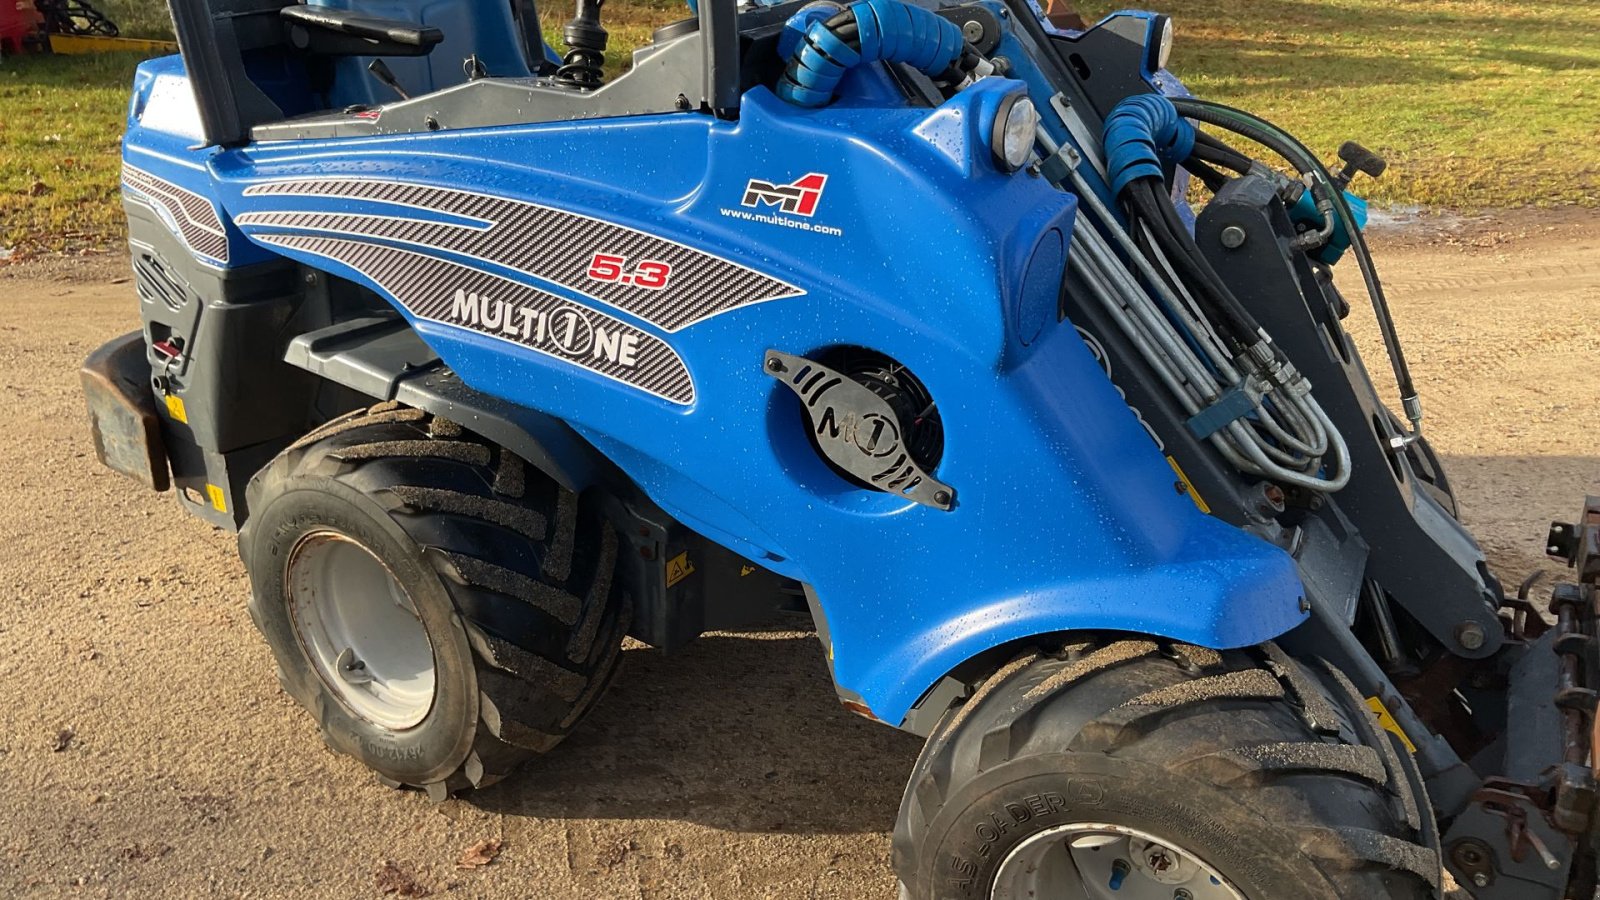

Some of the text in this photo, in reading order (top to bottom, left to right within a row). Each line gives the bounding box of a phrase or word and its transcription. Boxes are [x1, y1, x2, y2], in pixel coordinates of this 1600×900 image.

[741, 172, 828, 217] M1
[720, 208, 842, 236] www.multione.com
[587, 252, 671, 290] 5.3
